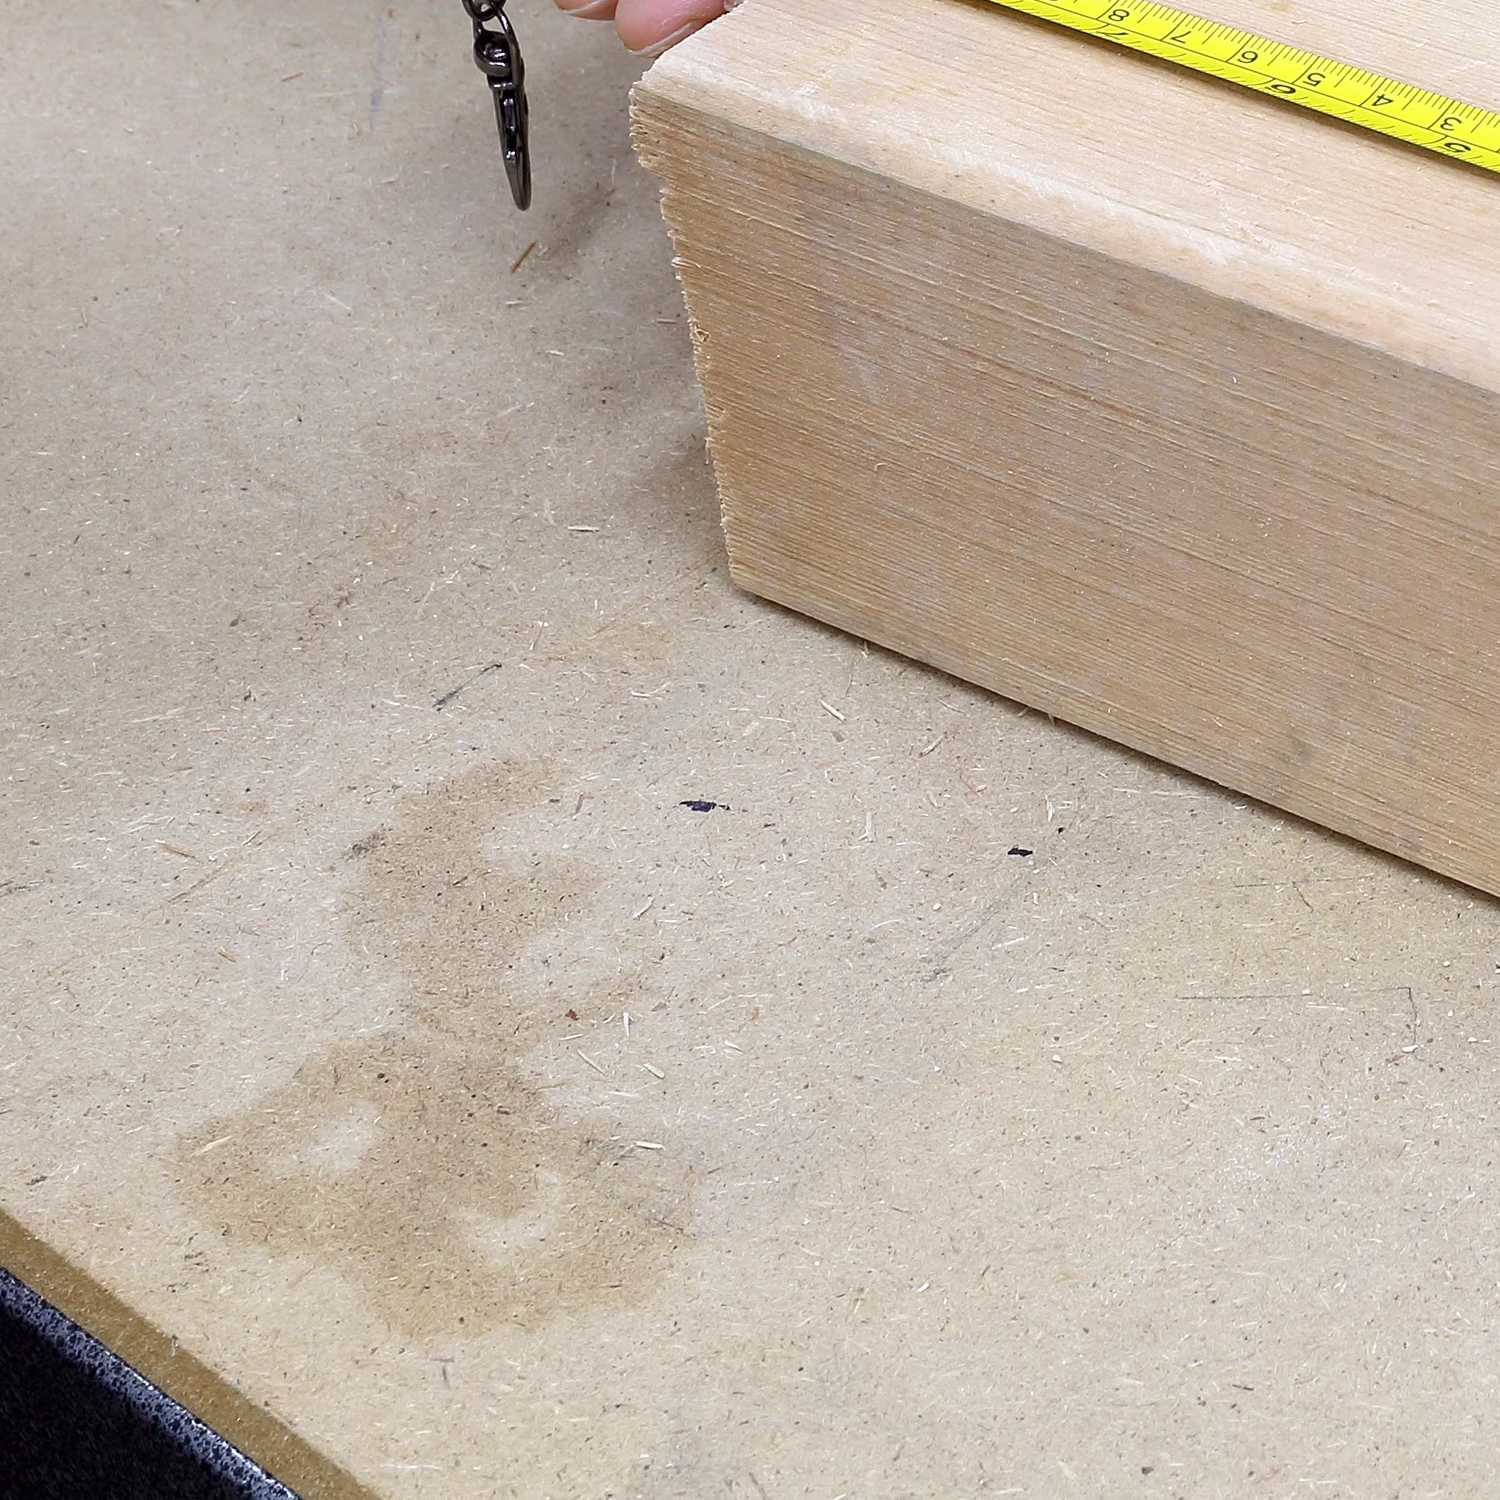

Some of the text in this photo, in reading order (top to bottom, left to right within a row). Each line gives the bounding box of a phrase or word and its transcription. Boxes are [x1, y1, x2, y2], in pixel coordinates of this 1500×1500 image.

[1108, 8, 1130, 22] 8
[1170, 31, 1192, 44] 7
[1237, 50, 1258, 64] 6
[1303, 72, 1326, 87] 5
[1372, 94, 1393, 107] 4
[1440, 116, 1462, 131] 3
